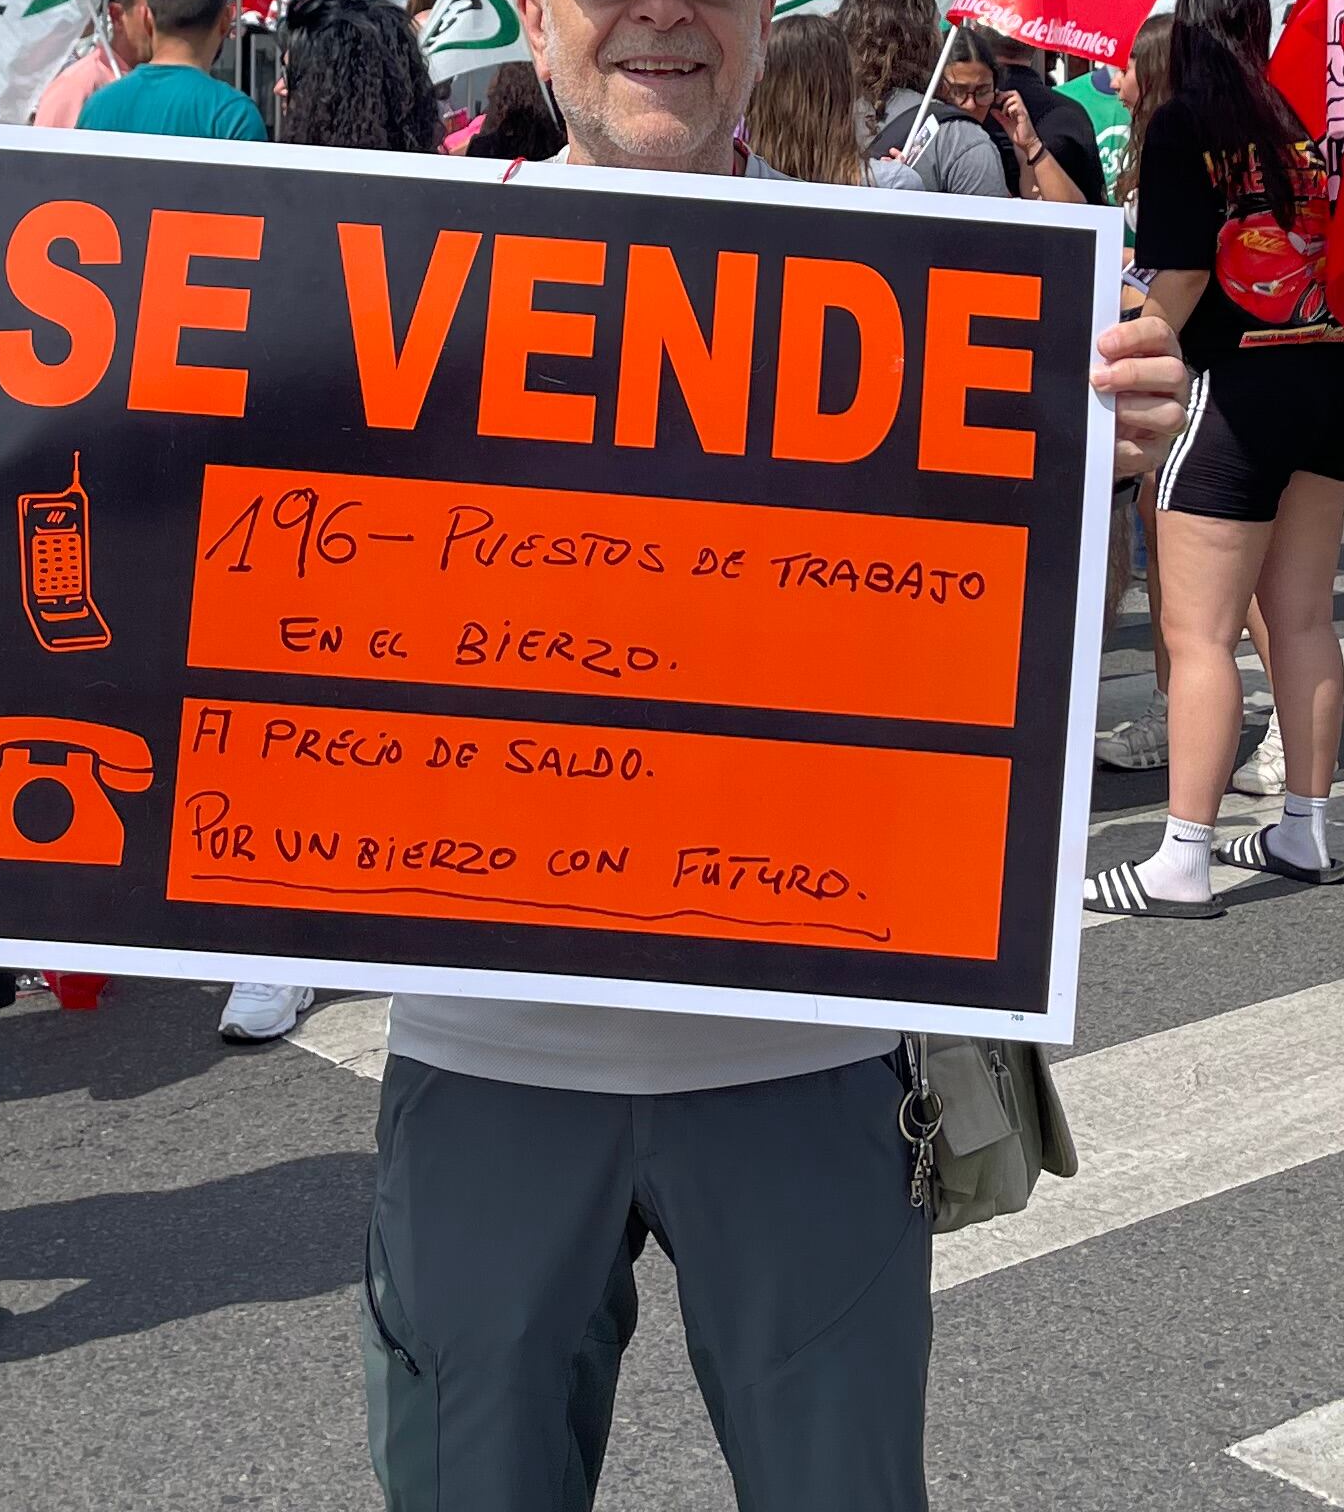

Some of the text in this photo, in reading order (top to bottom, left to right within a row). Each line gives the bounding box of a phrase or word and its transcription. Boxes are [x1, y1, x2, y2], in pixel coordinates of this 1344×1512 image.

[336, 221, 1044, 481] VENDE
[439, 504, 665, 574] PUESTOS
[690, 546, 747, 579] DE
[769, 552, 987, 605] TRABAJO
[278, 615, 344, 654] EN
[368, 628, 408, 660] EL
[425, 735, 480, 769] DE
[504, 738, 656, 782] SALDO.
[273, 826, 341, 863] UN
[546, 845, 630, 878] CON
